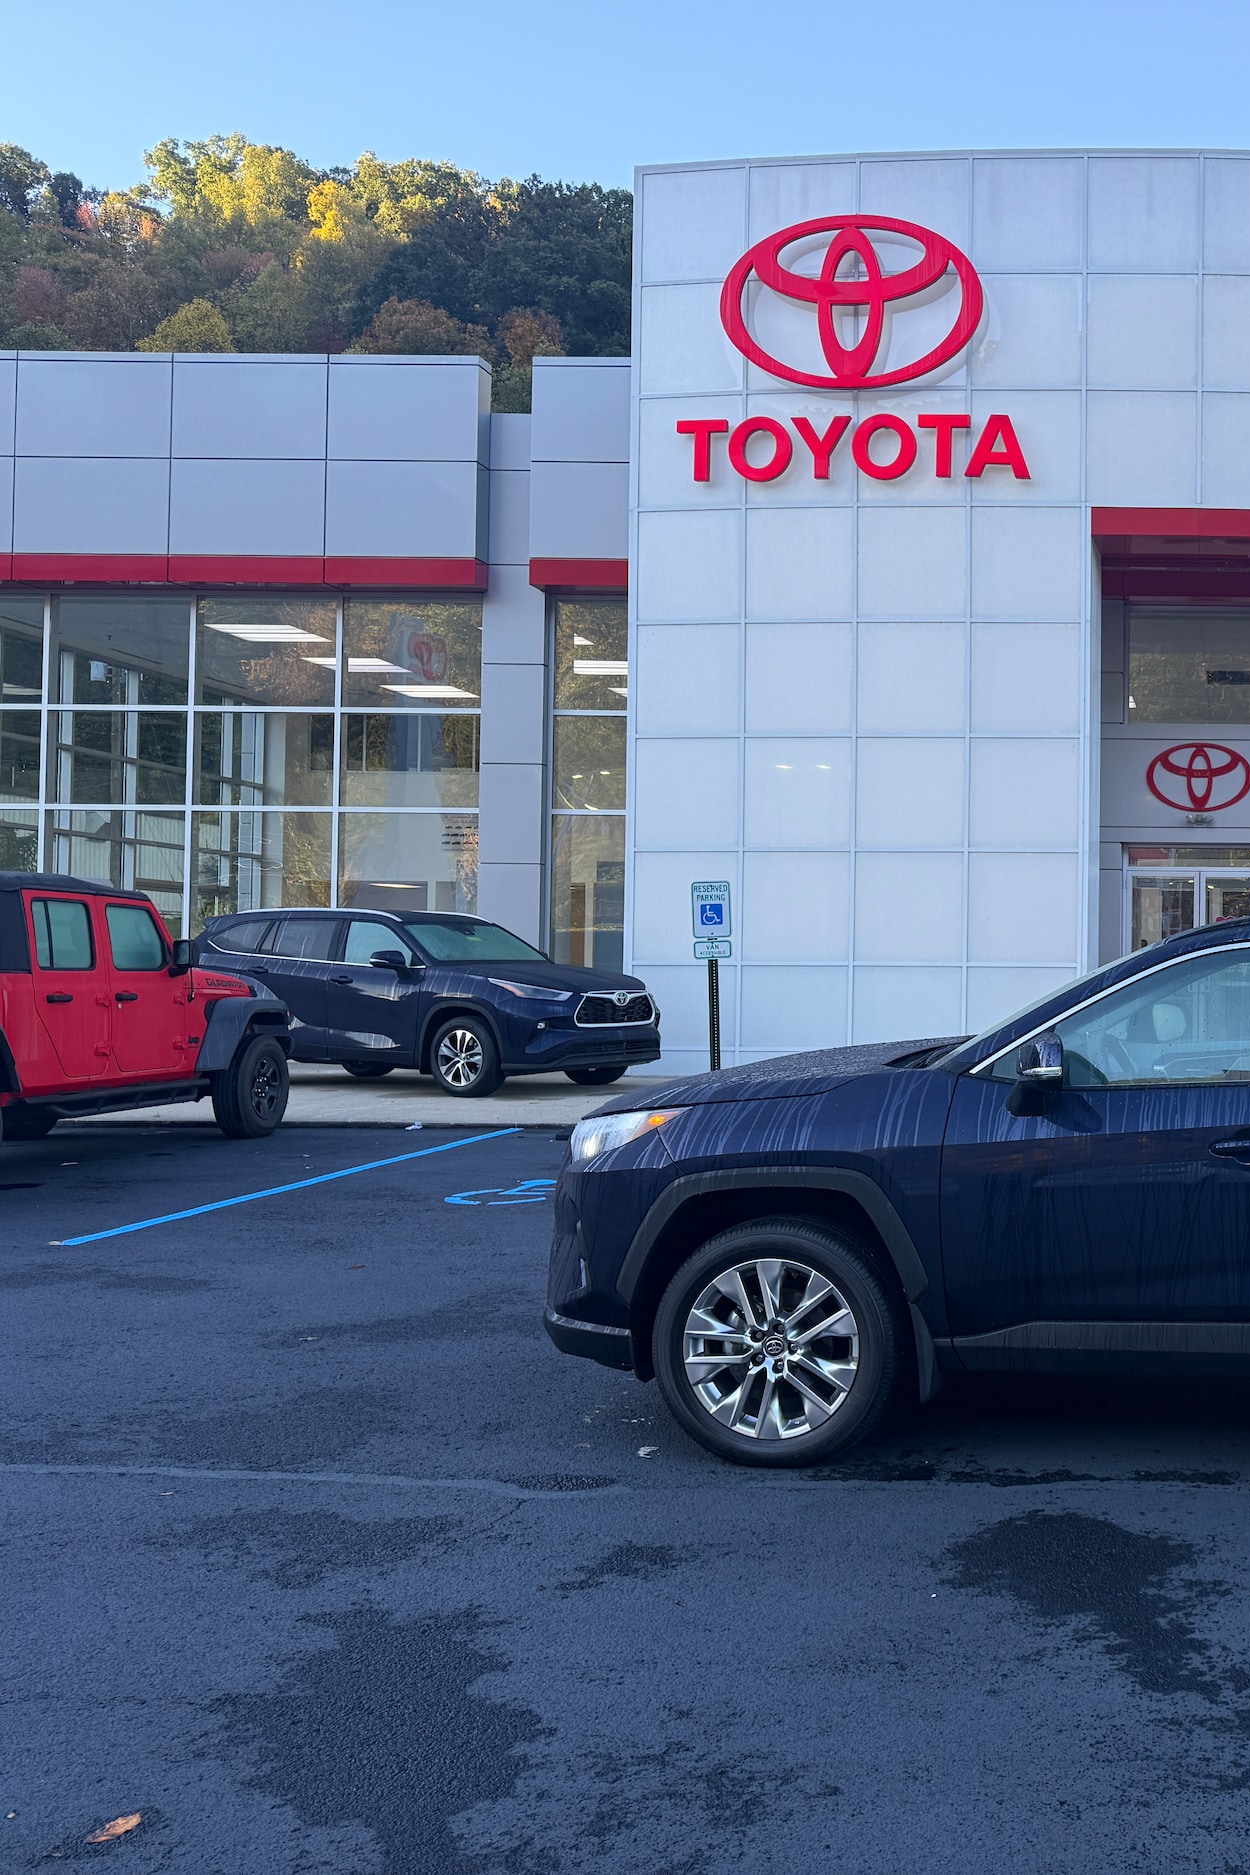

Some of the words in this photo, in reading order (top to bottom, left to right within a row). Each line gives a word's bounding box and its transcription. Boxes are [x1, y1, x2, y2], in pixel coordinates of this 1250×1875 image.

[676, 413, 1031, 483] TOYOTA
[693, 885, 728, 893] RESERVED
[697, 894, 726, 902] PARKING
[206, 978, 246, 989] GLADIATOR
